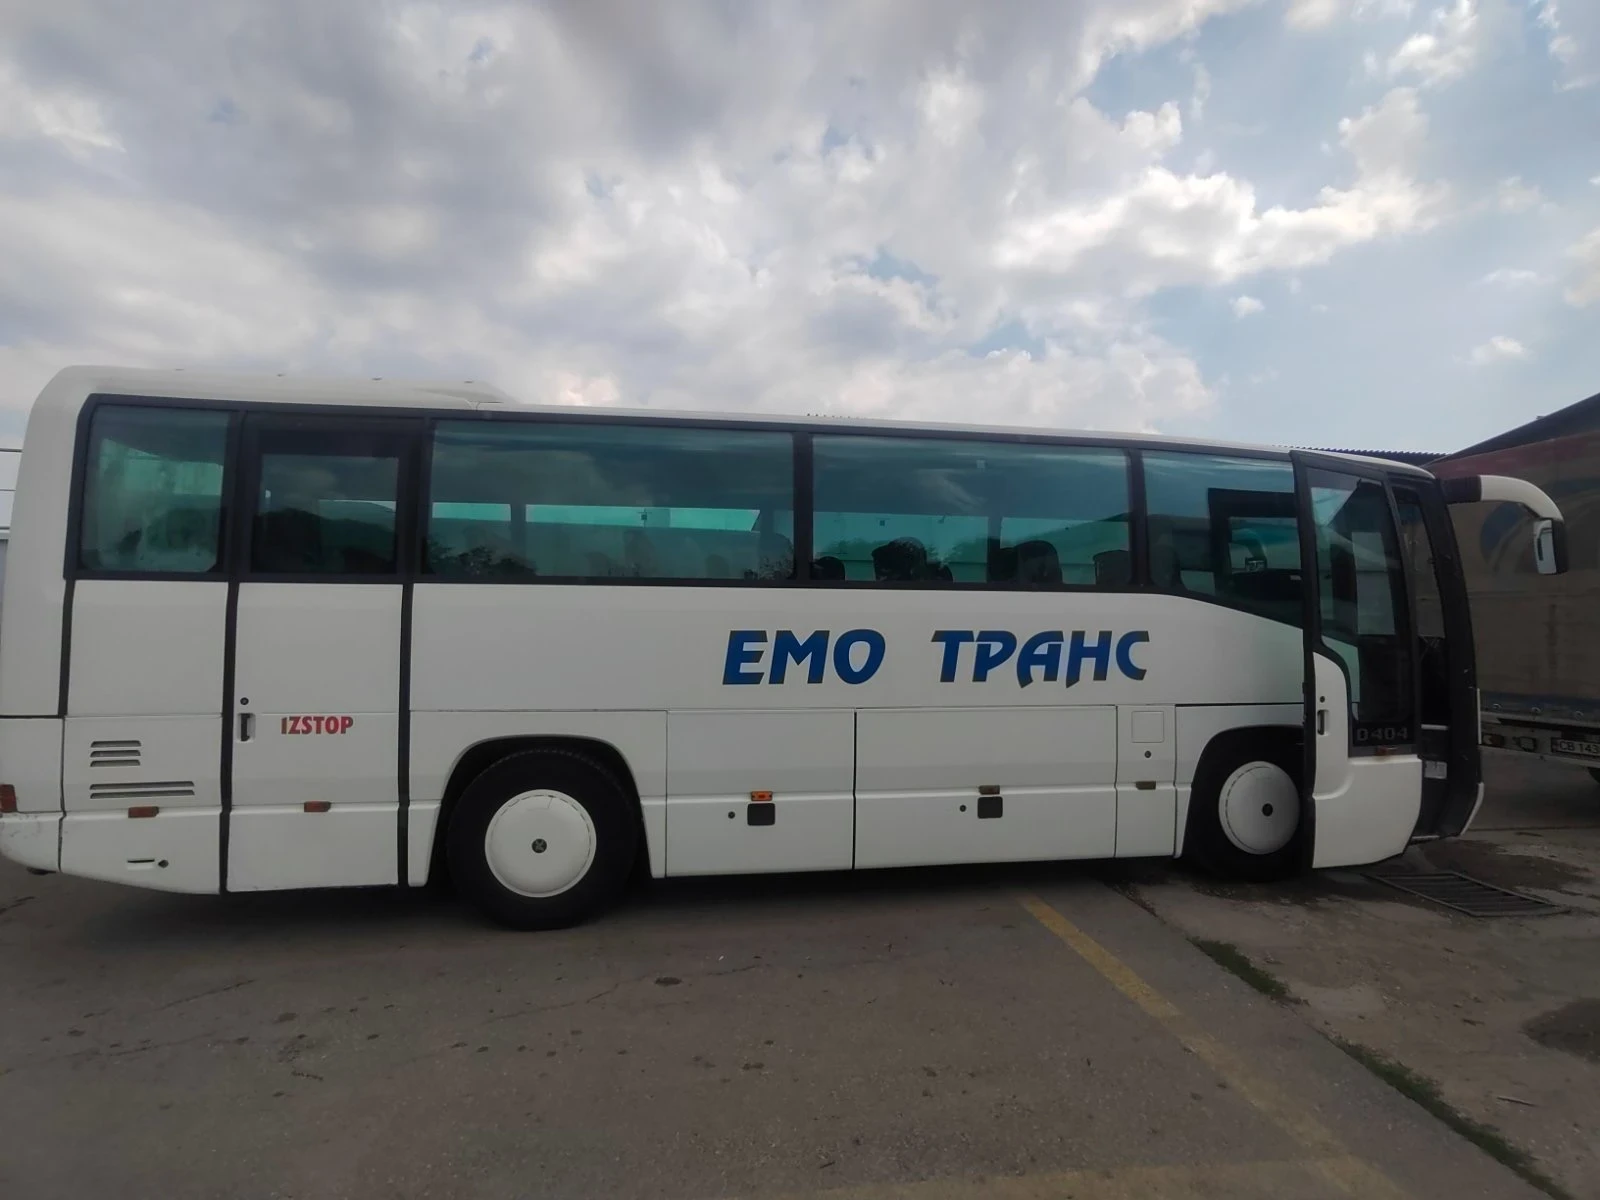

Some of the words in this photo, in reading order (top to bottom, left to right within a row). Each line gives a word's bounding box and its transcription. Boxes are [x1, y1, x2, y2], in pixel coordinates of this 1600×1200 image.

[722, 629, 886, 685] ЕМО
[930, 630, 1150, 688] ТРАНС
[281, 716, 354, 734] IZSTOP
